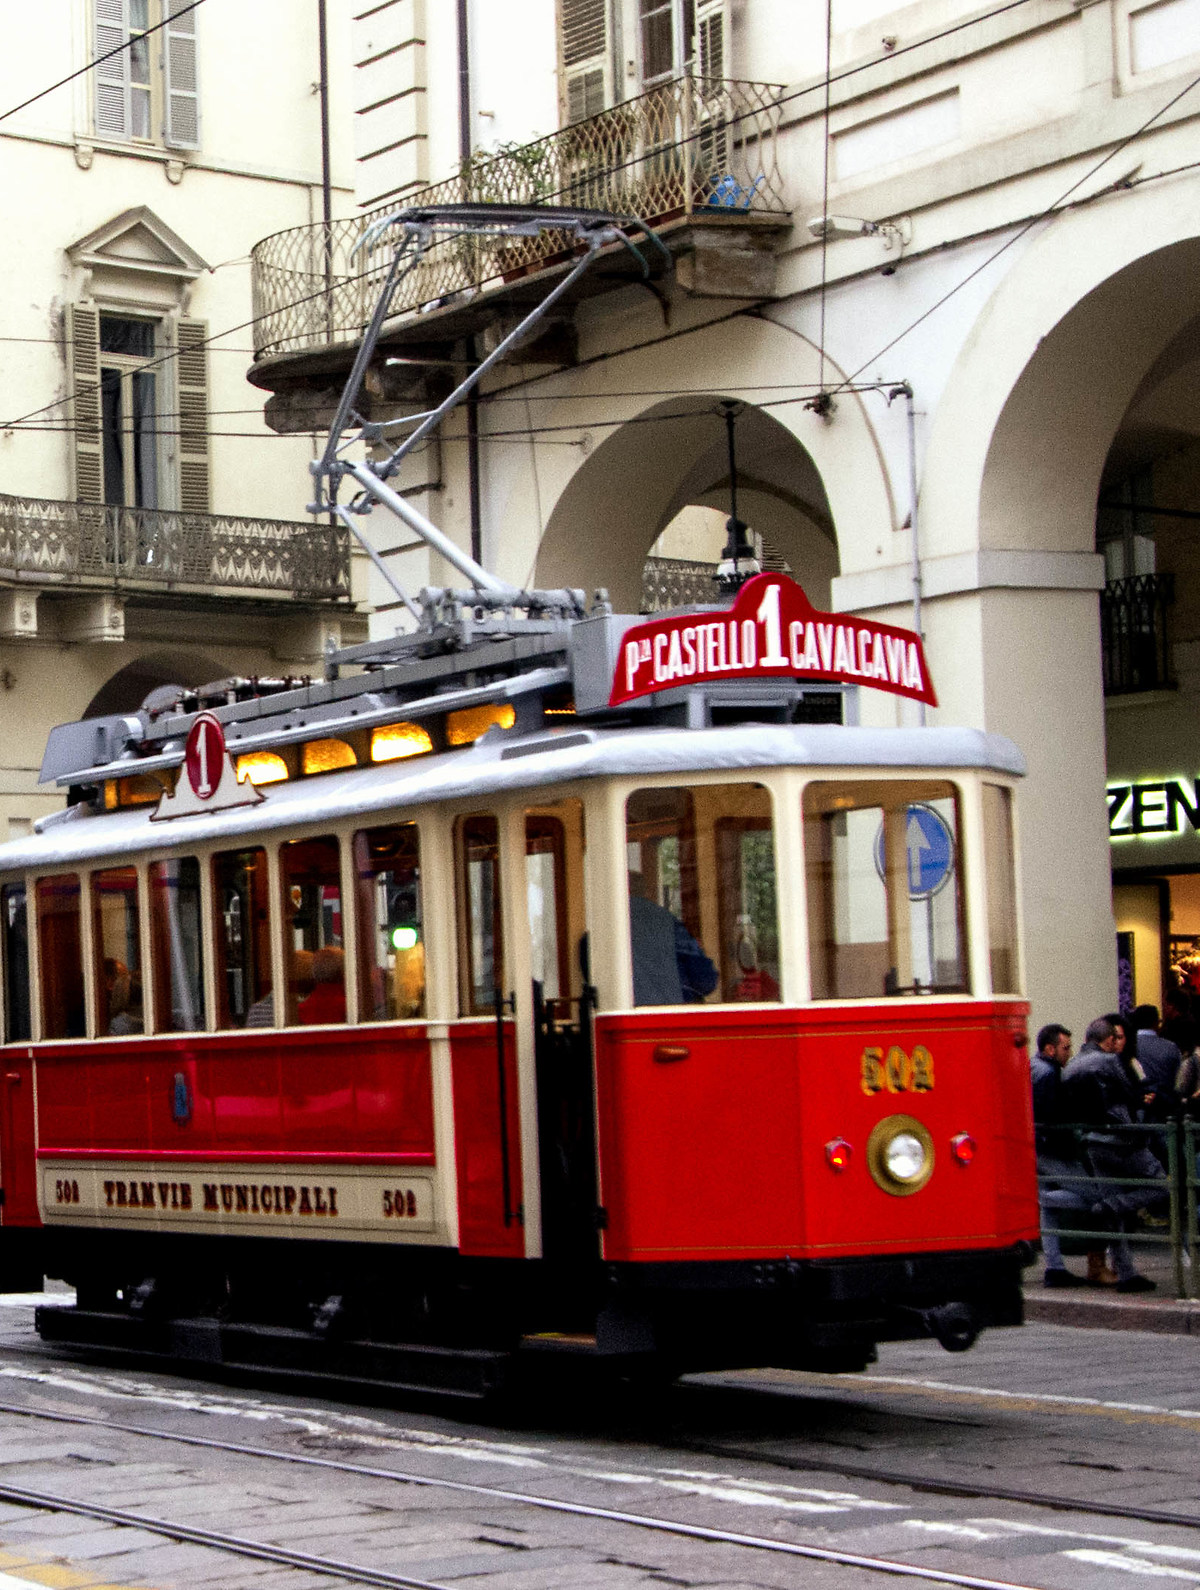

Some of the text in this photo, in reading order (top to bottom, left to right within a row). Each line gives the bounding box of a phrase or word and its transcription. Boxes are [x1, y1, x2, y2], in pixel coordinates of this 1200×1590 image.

[653, 619, 756, 682] CASTELLO
[757, 584, 789, 667] 1
[788, 620, 924, 691] CAVALCAVIA
[196, 722, 211, 793] 1
[861, 1045, 935, 1096] 502
[56, 1179, 417, 1218] 502 TRAMVIE MUNICIPALI 502
